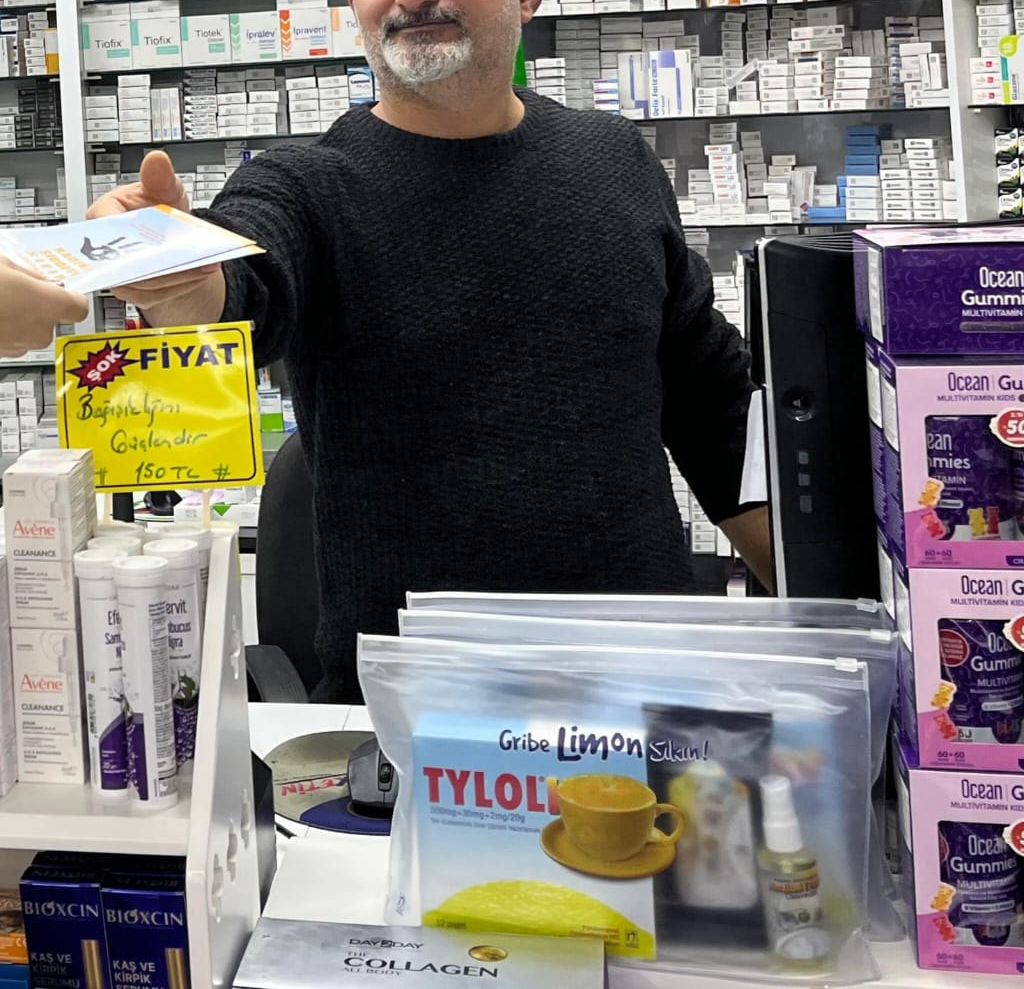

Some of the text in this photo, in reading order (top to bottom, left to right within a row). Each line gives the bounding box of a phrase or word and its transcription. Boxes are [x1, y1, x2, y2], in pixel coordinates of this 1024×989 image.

[144, 36, 172, 46] Tiofix
[196, 29, 223, 38] Tiotek
[94, 39, 122, 50] Tiofix
[87, 342, 239, 382] ŞOK FİYAT
[948, 372, 989, 391] Ocean
[136, 462, 165, 483] 150
[13, 519, 55, 536] Avène
[13, 549, 56, 557] CLEANANCE
[961, 575, 1002, 595] Ocean
[20, 674, 63, 690] Avène
[21, 703, 64, 712] CLEANANCE
[499, 729, 550, 752] Gribe
[556, 726, 643, 762] Limon
[961, 779, 1002, 800] Ocean
[24, 901, 100, 918] BIOXCIN
[106, 907, 184, 927] BIOXCIN
[30, 952, 72, 964] KAŞ VE
[113, 959, 156, 972] KAŞ VE
[343, 956, 498, 978] COLLAGEN
[114, 972, 152, 984] KİRPİK
